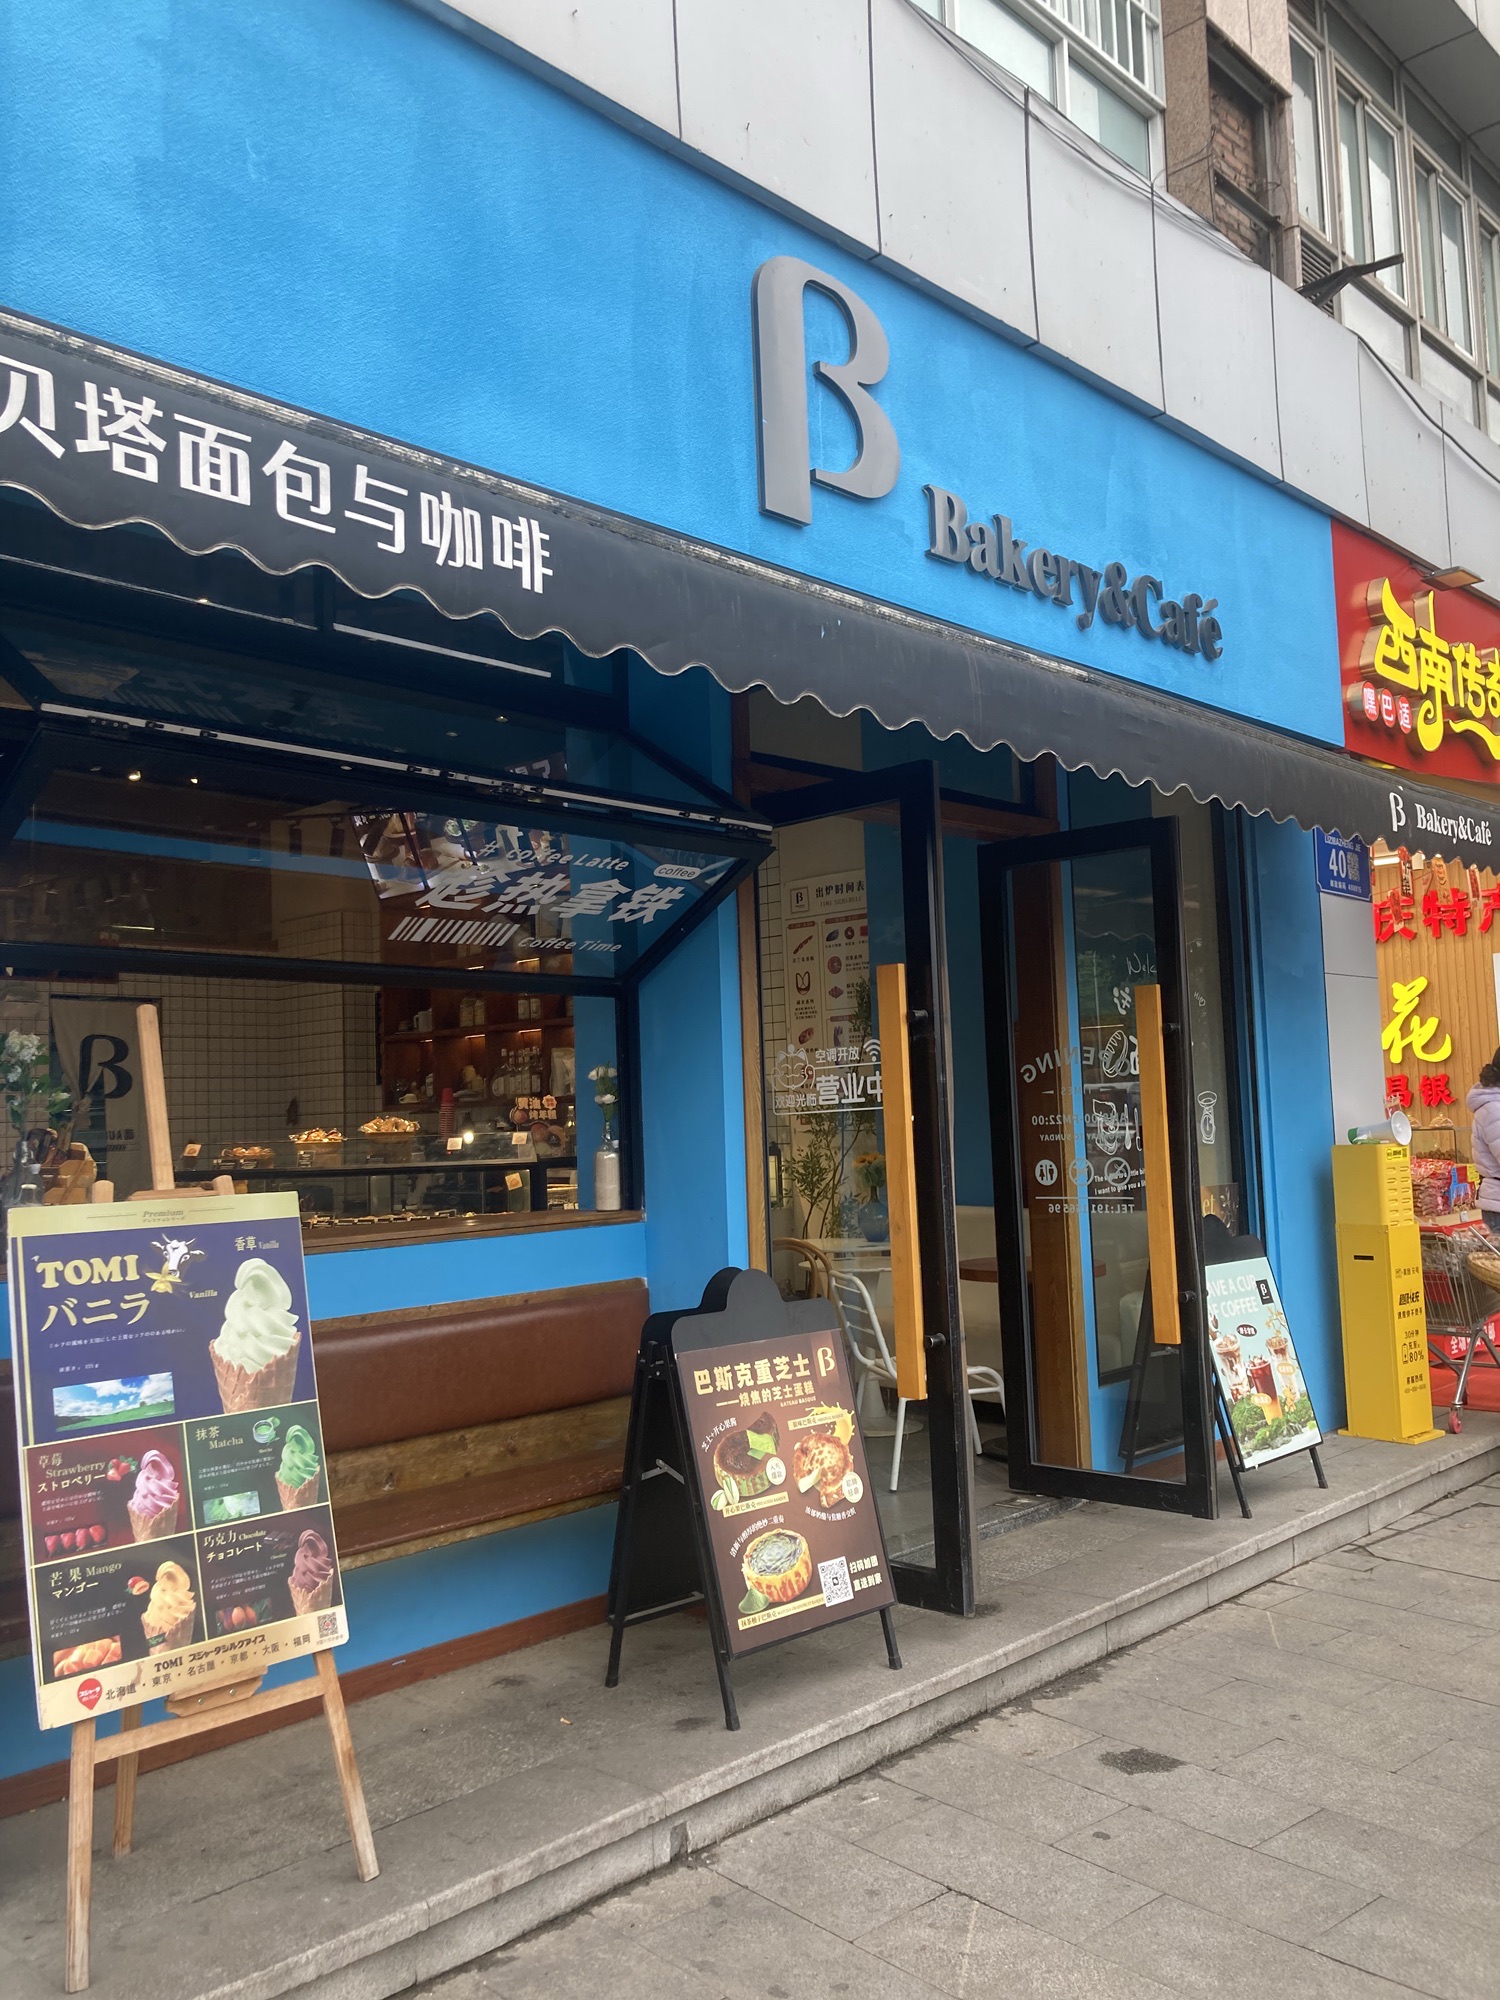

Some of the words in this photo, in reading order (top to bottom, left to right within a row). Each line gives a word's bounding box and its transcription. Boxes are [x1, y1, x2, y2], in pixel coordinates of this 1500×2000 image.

[0, 357, 554, 594] 贝塔面包与咖啡
[922, 483, 1224, 662] Bakery&Café
[1363, 685, 1412, 729] 嘿巴适
[1414, 803, 1493, 846] Bakery&Café
[573, 852, 630, 872] Latte
[1329, 848, 1347, 878] 40
[657, 866, 697, 879] coffee
[415, 865, 686, 924] 趁热拿铁
[816, 881, 865, 898] 出炉时间表
[517, 937, 578, 952] Coffee
[578, 940, 623, 953] Time
[1381, 976, 1452, 1064] 花
[815, 1046, 860, 1063] 空调开放
[816, 1071, 883, 1105] 营业中
[1385, 1073, 1457, 1108] 昌银
[775, 1093, 817, 1108] 欢迎光临
[143, 1208, 184, 1217] Premium
[234, 1235, 258, 1251] 香草
[36, 1254, 141, 1288] TOMI
[189, 1289, 218, 1299] Vanilla
[1228, 1277, 1237, 1294] A
[40, 1292, 151, 1332] バニラ
[1220, 1296, 1260, 1318] COFFEE
[1404, 1329, 1419, 1339] 30分钟
[1409, 1350, 1424, 1363] 80%
[693, 1353, 811, 1395] 巴斯克重芝士
[195, 1426, 220, 1441] 抹茶
[209, 1437, 244, 1450] Matcha
[39, 1452, 64, 1469] 草莓
[45, 1461, 107, 1480] Strawberry
[37, 1473, 107, 1494] ストロベリー
[204, 1529, 237, 1548] 巧克力
[238, 1529, 267, 1541] Chocolate
[206, 1541, 262, 1563] チョコレート
[85, 1562, 122, 1577] Mango
[52, 1581, 99, 1599] マンゴー
[853, 1572, 883, 1592] 直送到家
[154, 1656, 183, 1673] TOMI
